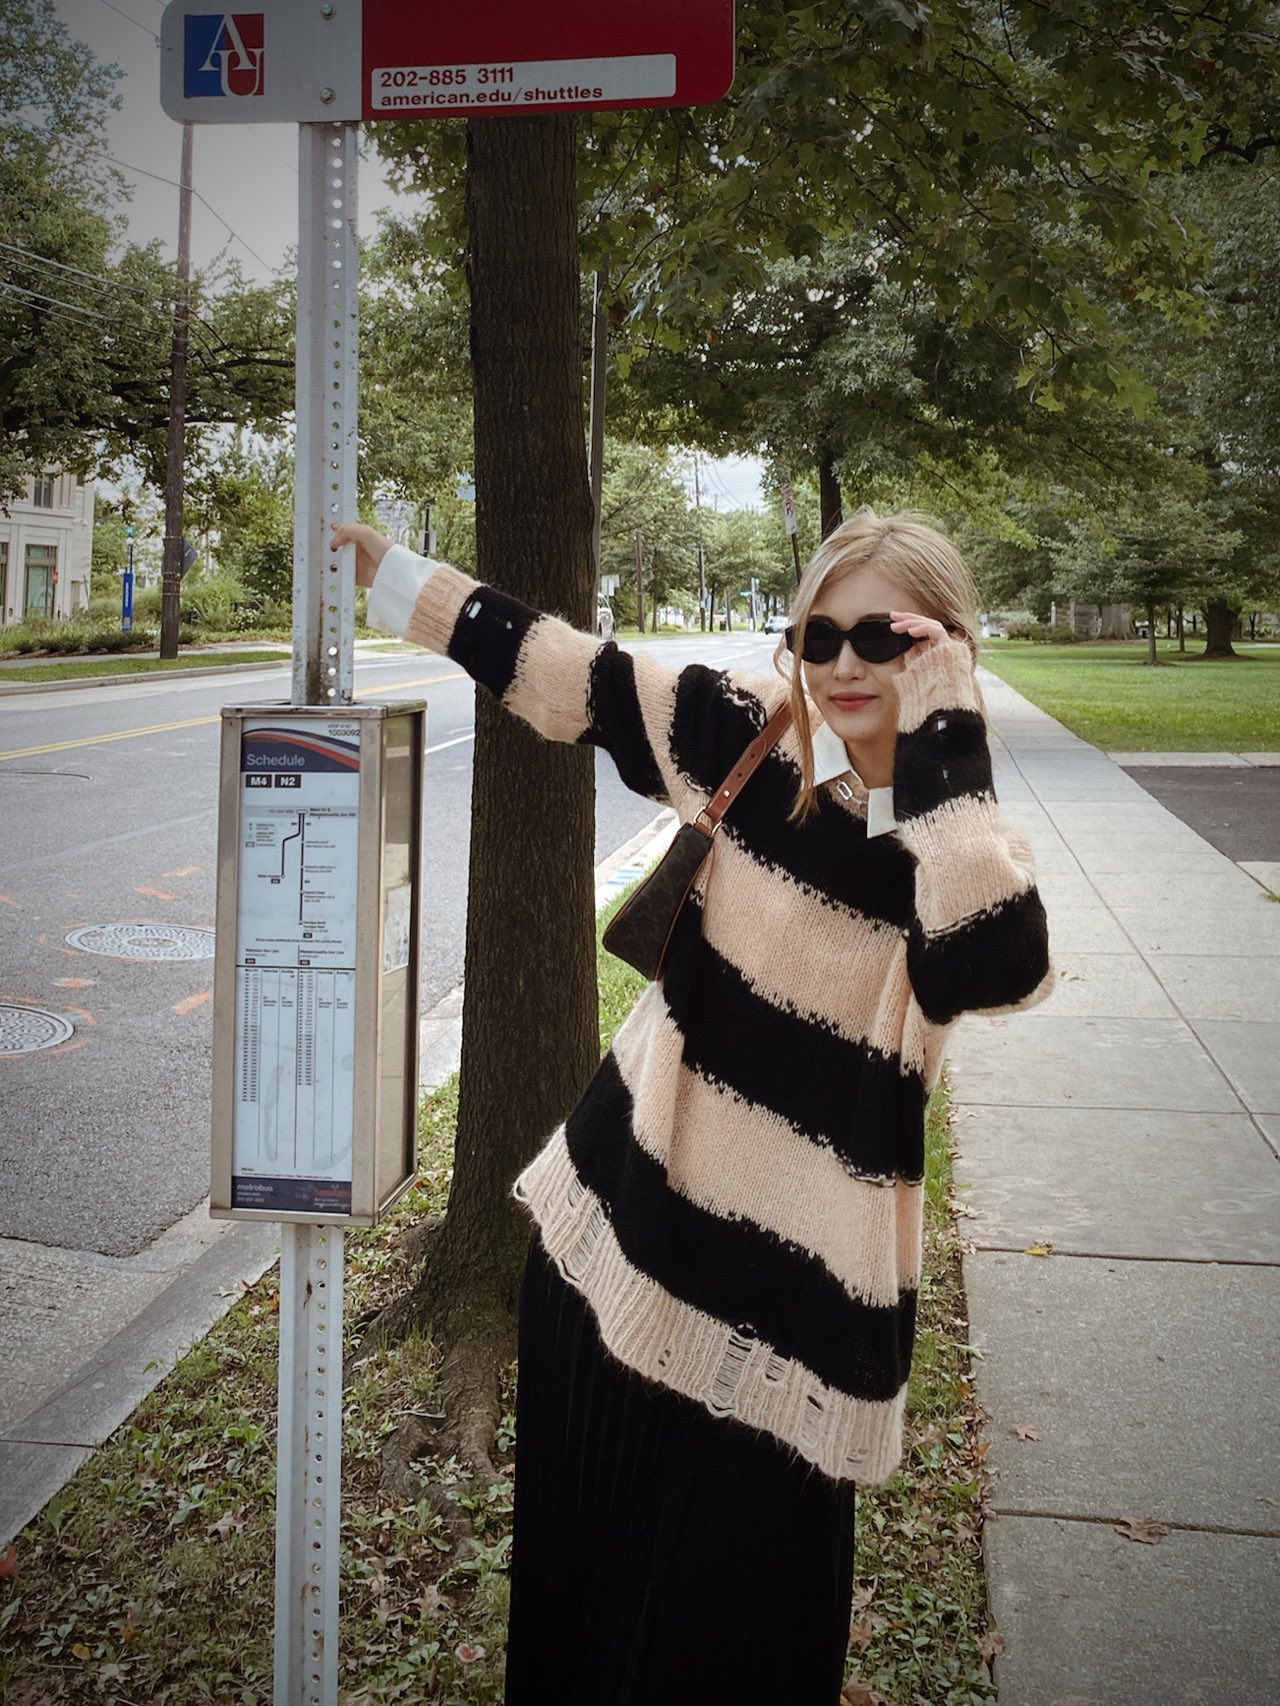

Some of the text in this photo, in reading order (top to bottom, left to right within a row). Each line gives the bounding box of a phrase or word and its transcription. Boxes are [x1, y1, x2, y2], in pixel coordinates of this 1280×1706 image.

[197, 13, 265, 97] AU
[380, 66, 514, 88] 202-885 3111
[381, 85, 603, 106] american.edu/shuttles
[246, 753, 306, 767] Schedule
[250, 776, 296, 786] M4 N2
